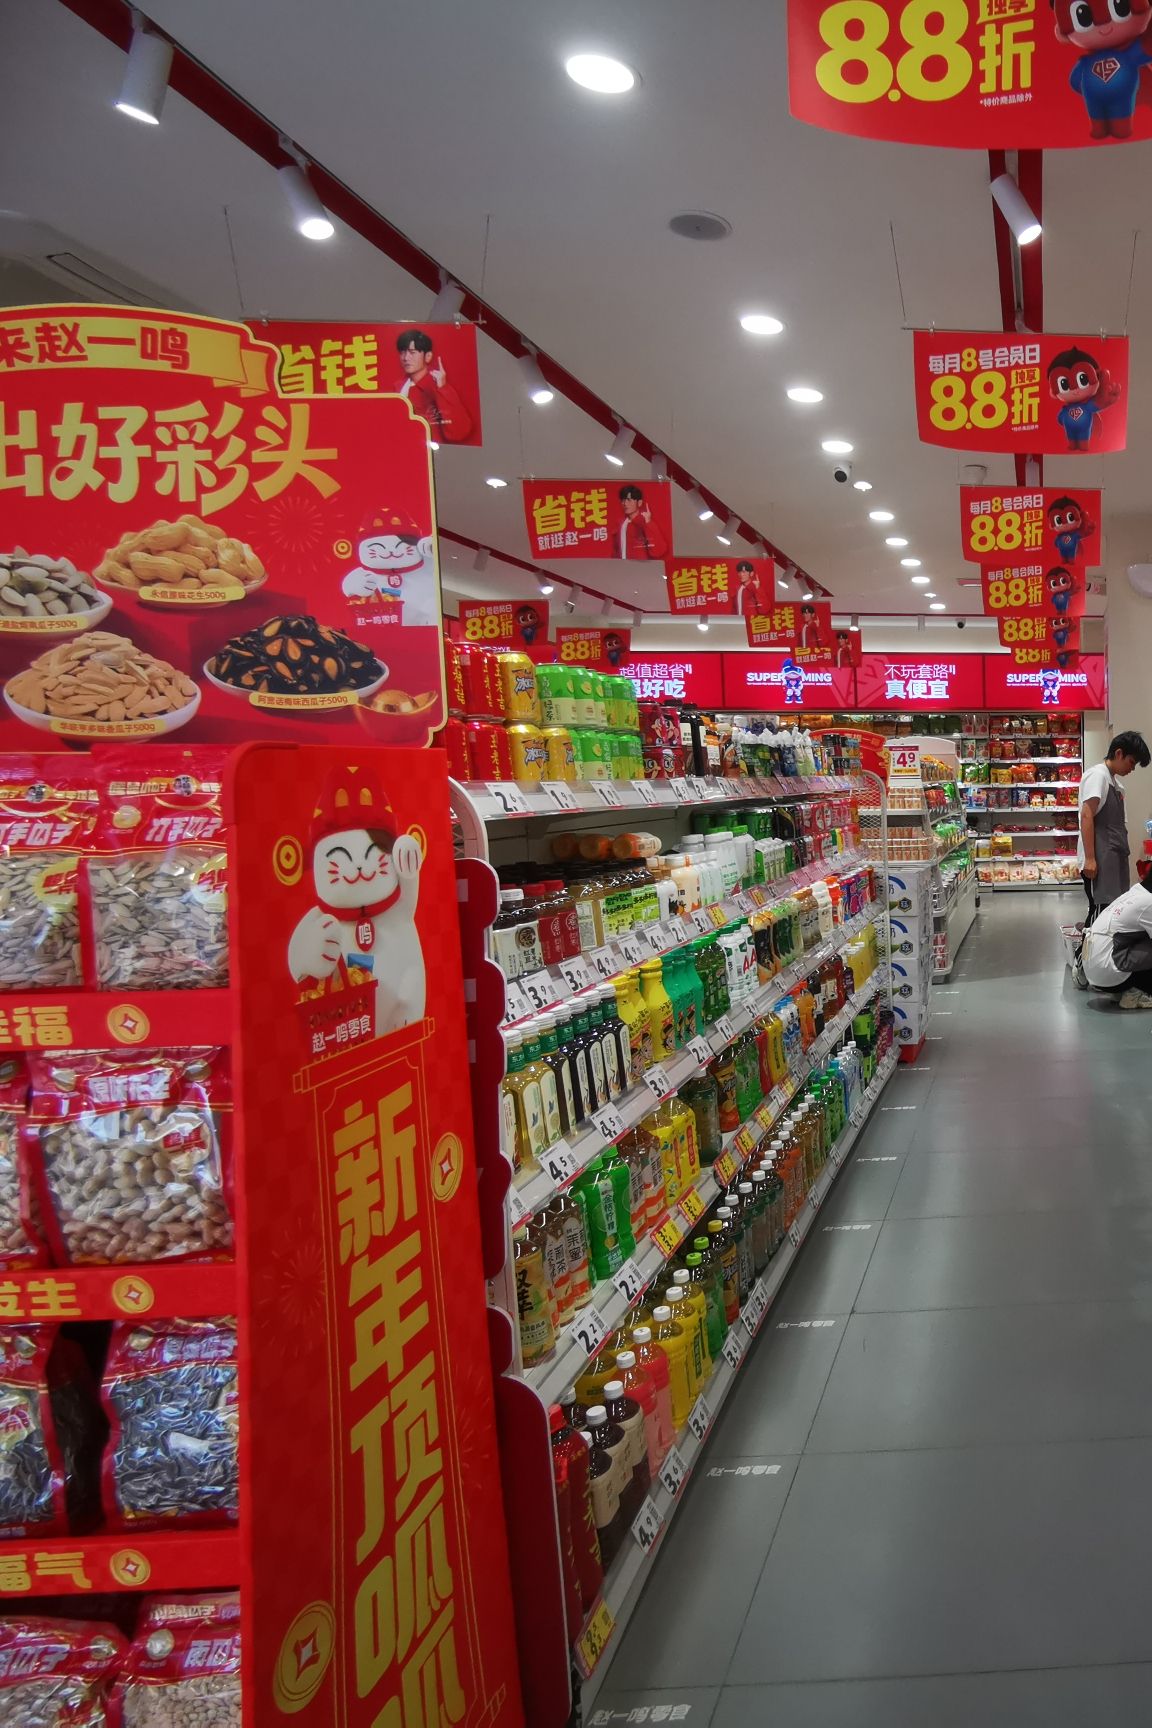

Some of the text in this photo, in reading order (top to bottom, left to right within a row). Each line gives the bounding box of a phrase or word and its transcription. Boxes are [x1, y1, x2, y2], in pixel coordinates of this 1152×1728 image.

[0, 322, 190, 371] 来赵一鸣
[280, 335, 378, 394] 省钱
[929, 344, 1040, 374] 每月8号会员日
[532, 488, 608, 535] 省钱
[970, 494, 1043, 514] 每月8号会员日
[538, 526, 608, 551] 就逛赵一鸣
[672, 563, 728, 597] 省钱
[988, 565, 1042, 581] 每月8号会员日
[676, 592, 728, 609] 就逛赵一鸣
[750, 607, 794, 634] 省钱
[753, 628, 795, 643] 就逛赵一鸣
[747, 672, 784, 683] SUPER
[802, 672, 832, 683] MING
[885, 663, 949, 678] 不玩套路
[1007, 673, 1041, 683] SUPER
[1059, 673, 1087, 683] MING
[885, 679, 950, 700] 真便宜
[897, 752, 916, 768] 4.9
[0, 822, 73, 845] 手瓜子
[359, 922, 373, 945] 鸣
[565, 970, 583, 992] 3.9
[528, 985, 548, 1009] 3.9
[312, 1015, 371, 1053] 赵一鸣零食
[649, 1077, 665, 1097] 3.9
[600, 1117, 617, 1139] 4.5
[550, 1156, 569, 1182] 4.5
[619, 1274, 637, 1301] 2.2
[577, 1323, 599, 1354] 2.2
[331, 1088, 468, 1728] 新年顶呱呱
[664, 1465, 680, 1497] 3.6
[587, 1704, 692, 1726] 赵一鸣零食
